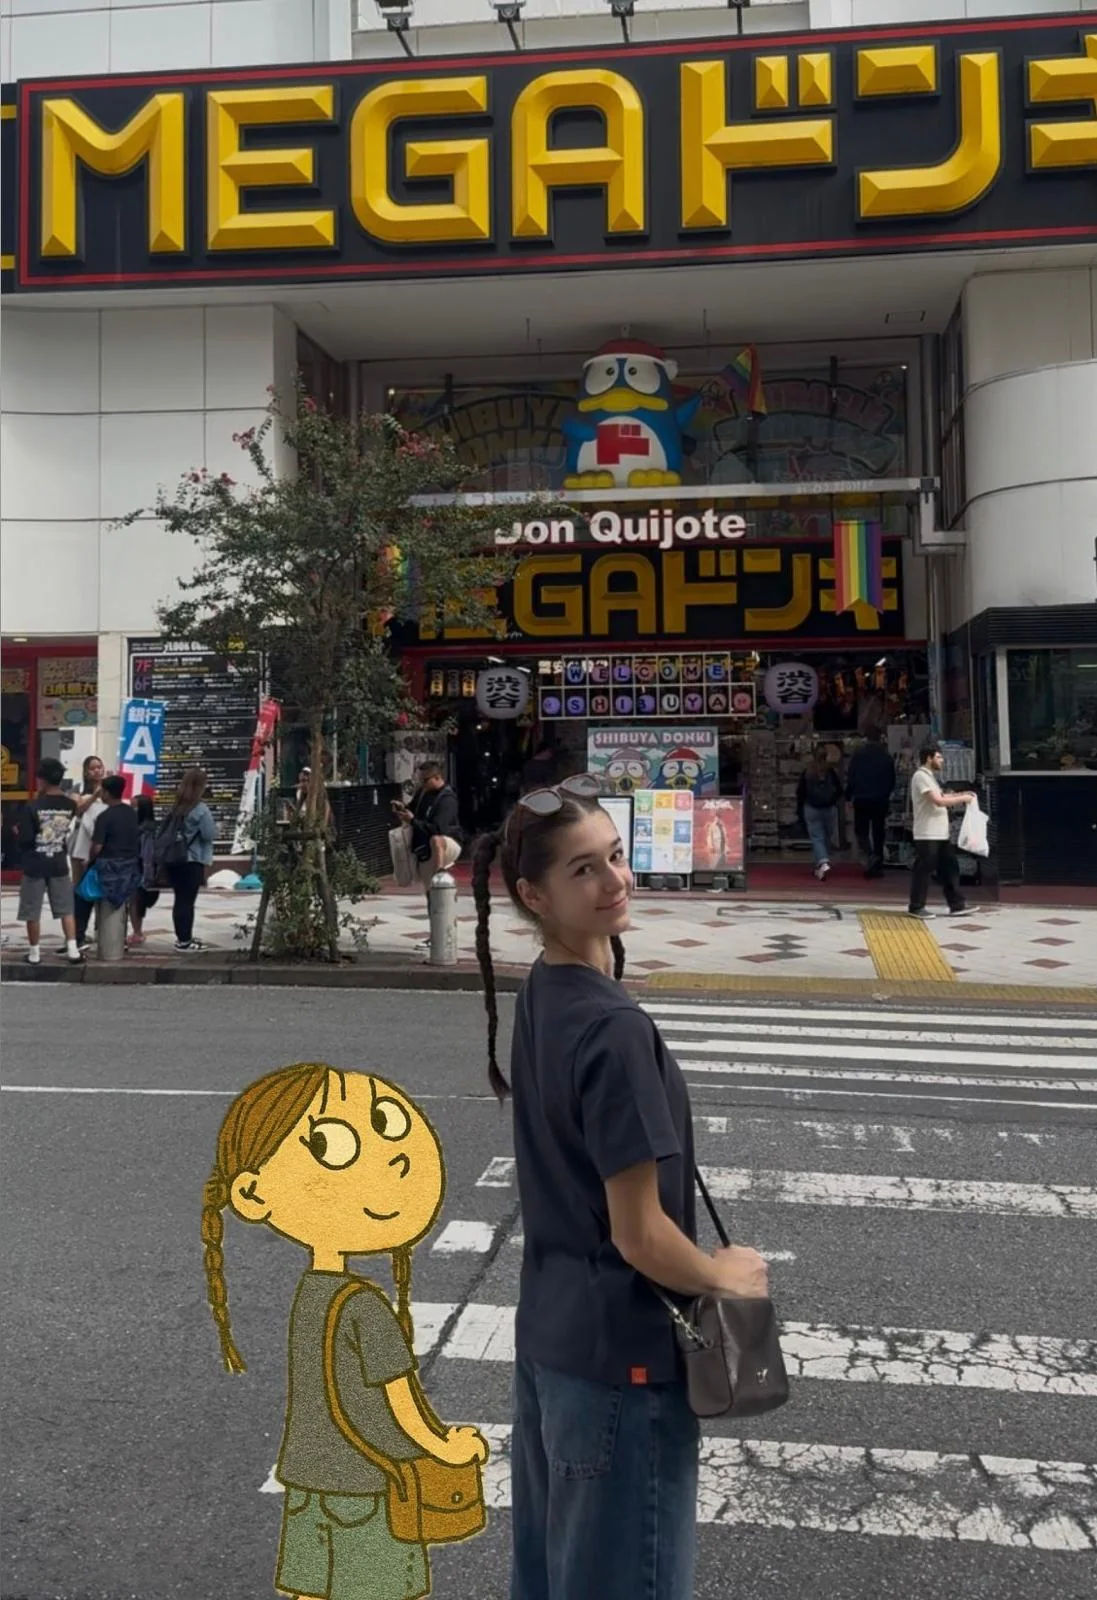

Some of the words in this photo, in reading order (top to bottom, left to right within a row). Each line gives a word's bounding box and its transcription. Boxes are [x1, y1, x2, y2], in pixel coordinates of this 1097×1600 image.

[596, 424, 650, 466] ド
[590, 508, 746, 549] Quijote
[569, 664, 722, 679] WELCOME
[486, 675, 520, 709] 渋谷
[776, 670, 812, 704] 渋谷
[128, 706, 162, 725] 銀行
[570, 695, 724, 710] SHIBUYA
[595, 731, 658, 744] SHIBUYA
[662, 731, 711, 744] DONKI
